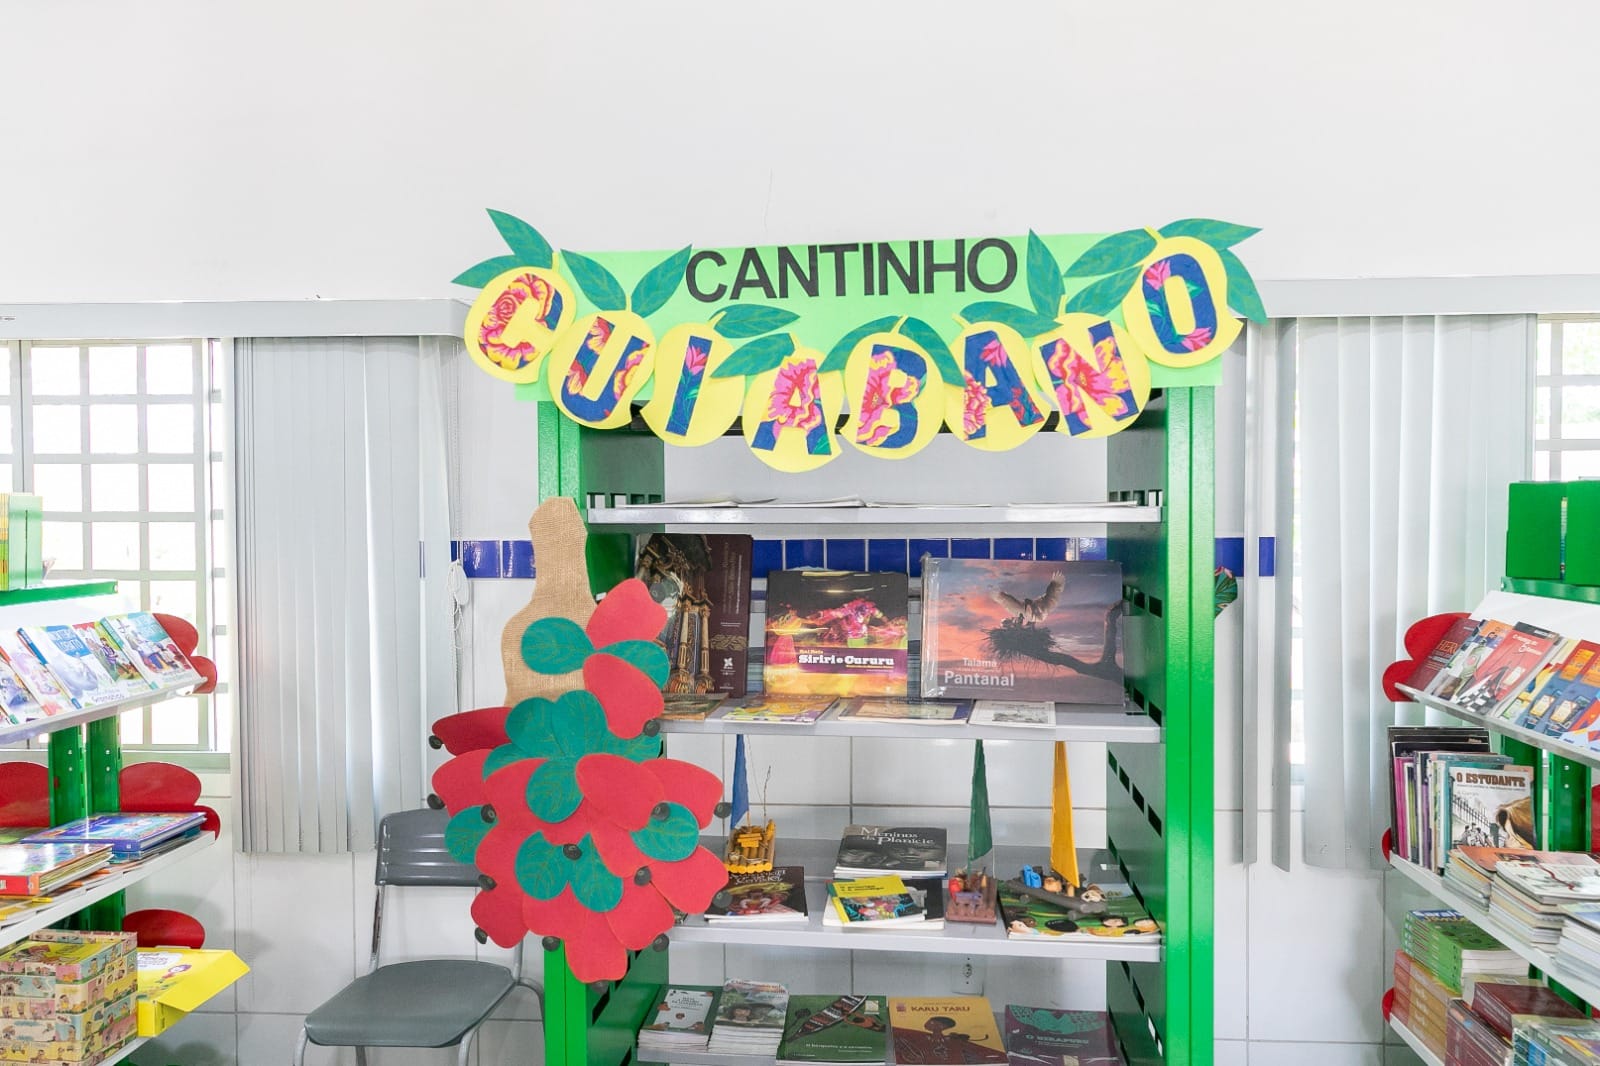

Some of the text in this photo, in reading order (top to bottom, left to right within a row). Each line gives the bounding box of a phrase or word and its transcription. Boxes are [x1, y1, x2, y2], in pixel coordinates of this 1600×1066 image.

[685, 237, 1018, 303] CANTINHO
[476, 252, 1219, 457] CUIABANO
[798, 654, 836, 664] Siriri
[844, 655, 895, 665] Cururu
[944, 670, 1015, 687] Pantanal
[1456, 772, 1463, 783] O
[1466, 773, 1526, 788] ESTUDANTE
